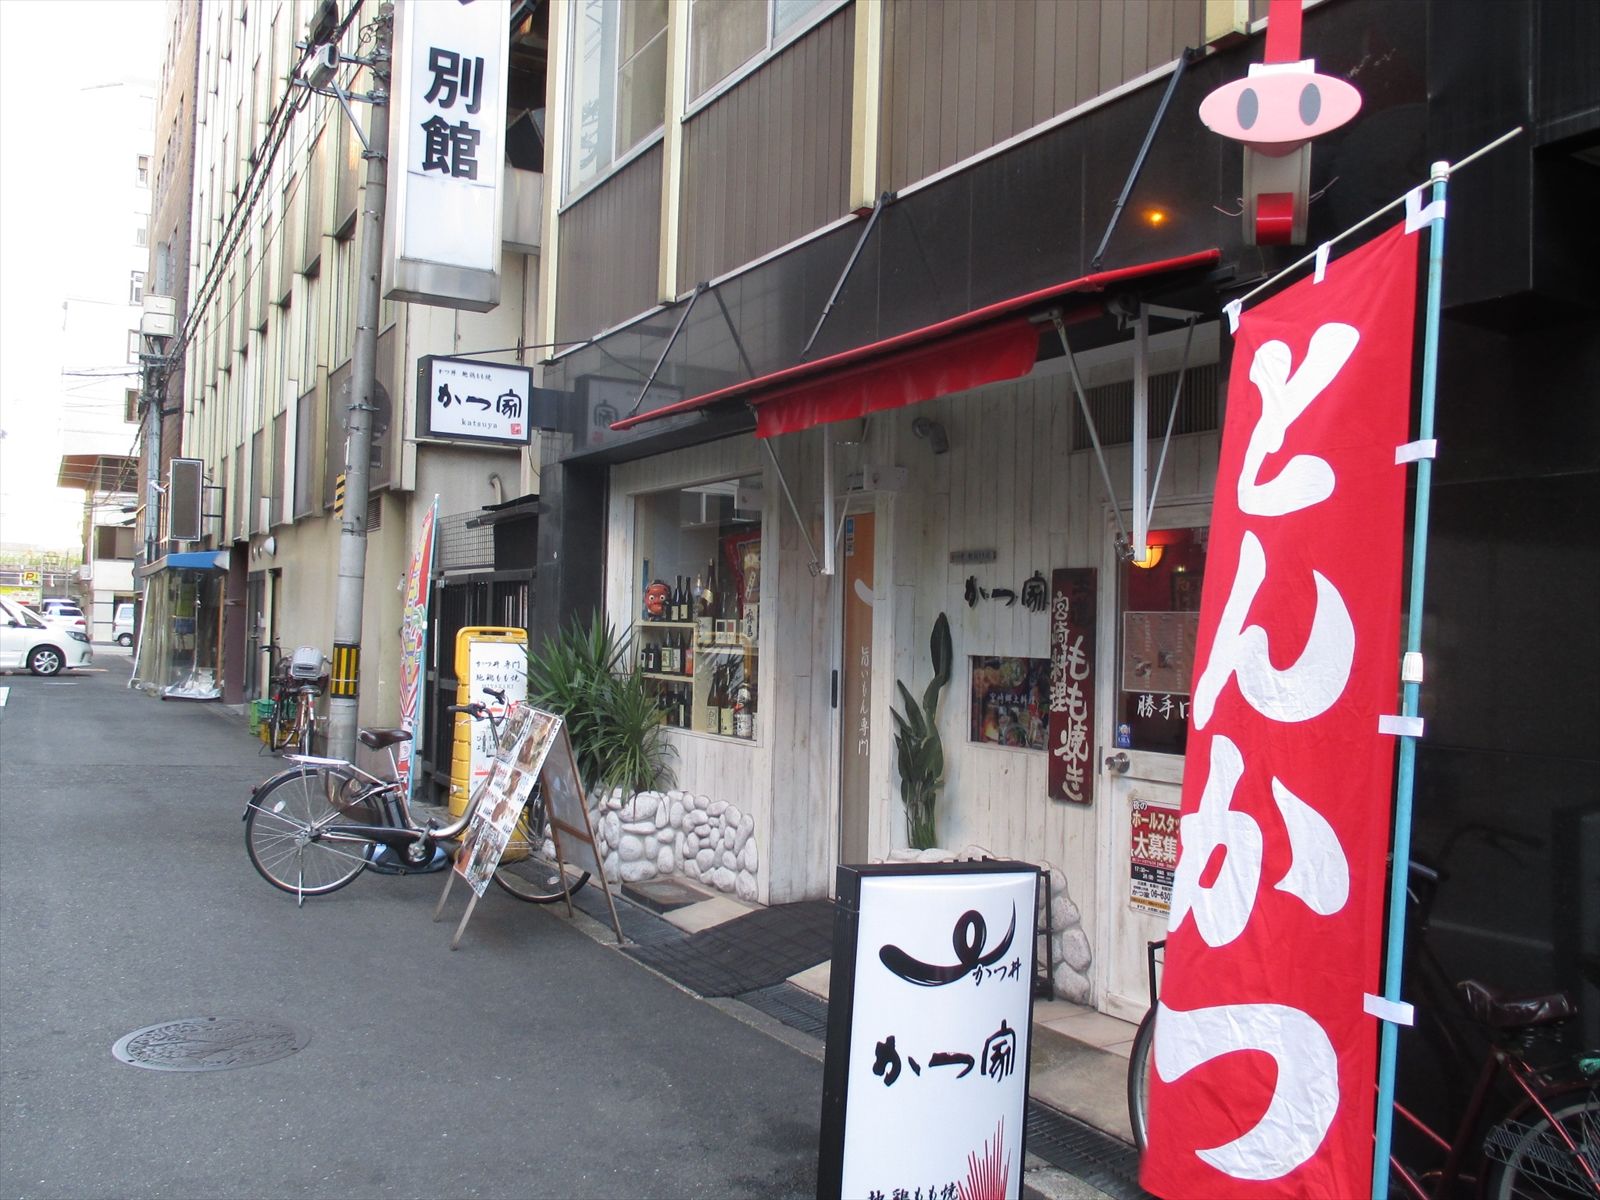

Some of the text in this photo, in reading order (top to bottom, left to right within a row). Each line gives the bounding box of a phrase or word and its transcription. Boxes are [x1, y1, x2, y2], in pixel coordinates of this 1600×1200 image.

[421, 47, 485, 180] 別館
[437, 383, 522, 418] かつ家
[461, 418, 498, 429] katsuya
[964, 570, 1048, 613] かつ家
[1054, 635, 1090, 800] もも焼き
[1155, 323, 1360, 1180] とんかつ
[1132, 830, 1178, 863] 大募集
[972, 957, 1021, 986] かつ丼
[872, 1019, 1017, 1086] かつ家
